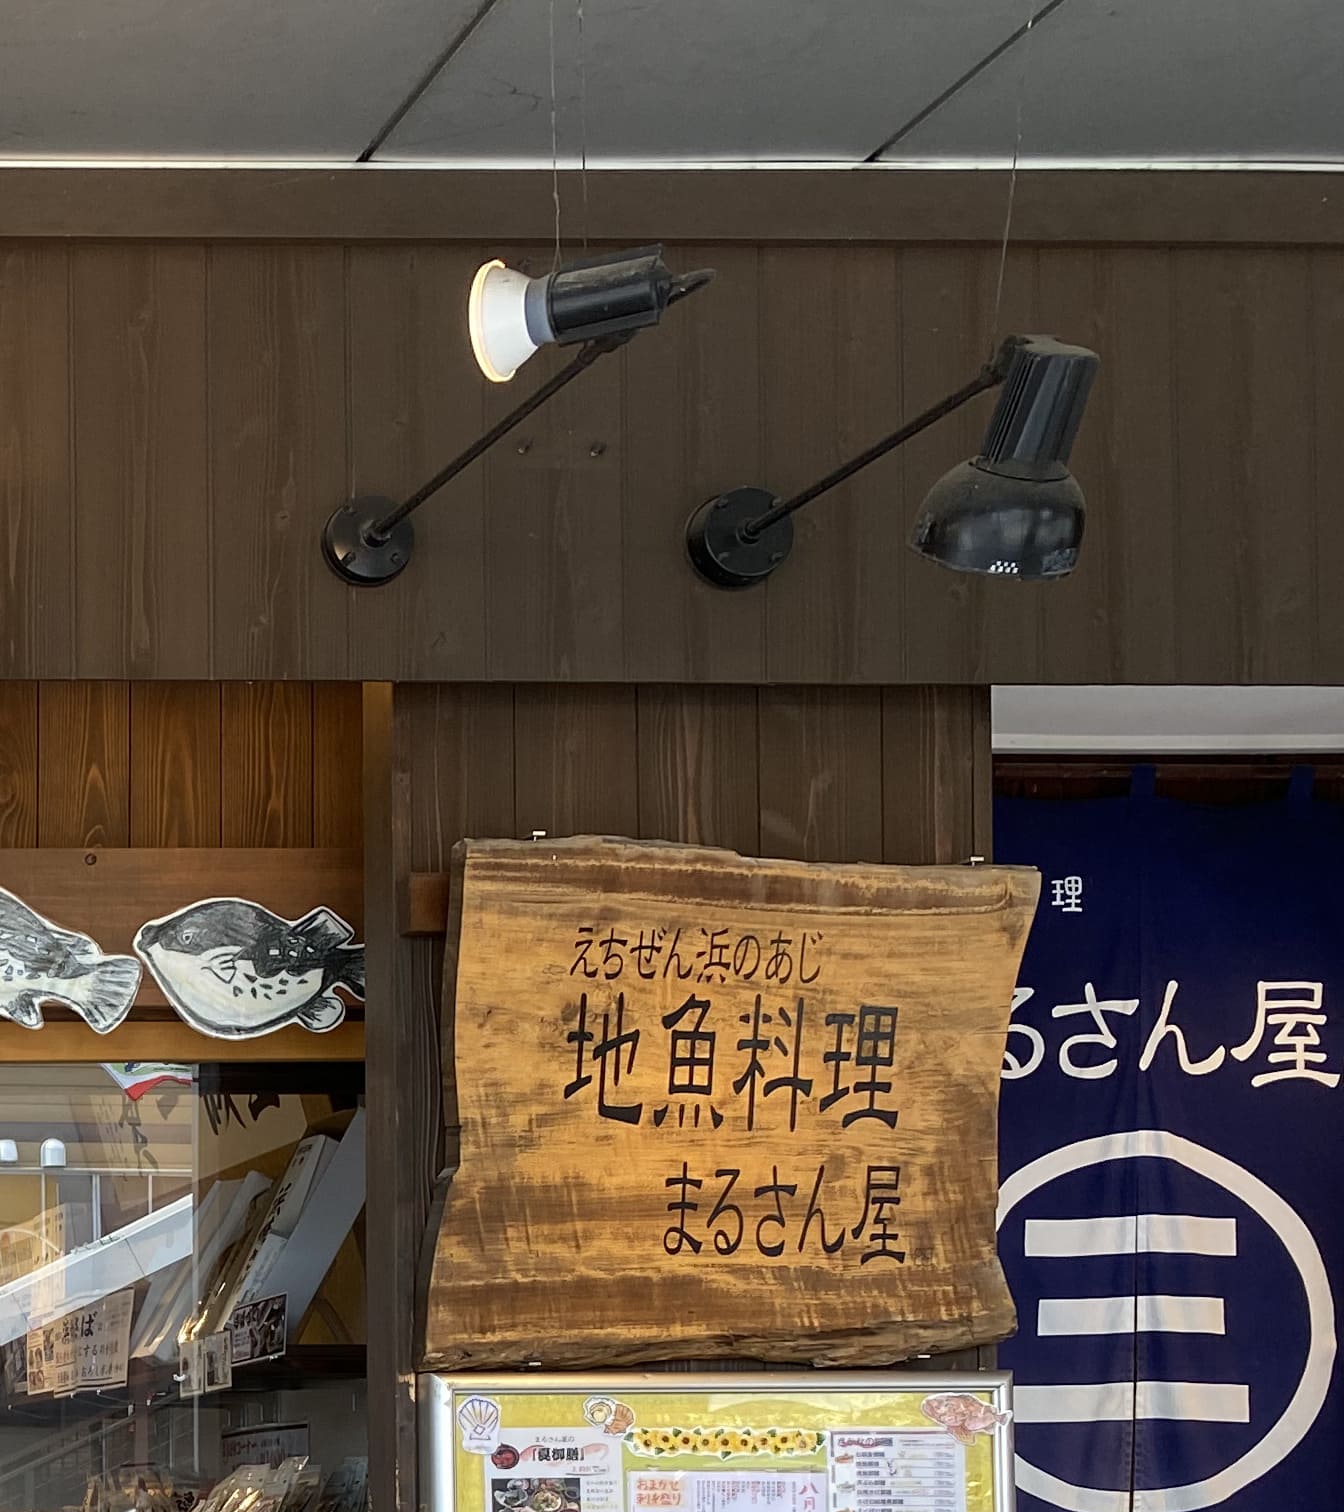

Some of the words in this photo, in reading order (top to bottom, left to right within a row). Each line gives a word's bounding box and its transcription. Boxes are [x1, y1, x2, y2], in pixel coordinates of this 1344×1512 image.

[1052, 876, 1083, 913] 理
[569, 927, 825, 984] えちぜん浜のあじ
[563, 992, 898, 1131] 地魚料理
[663, 1161, 906, 1265] まるさん屋
